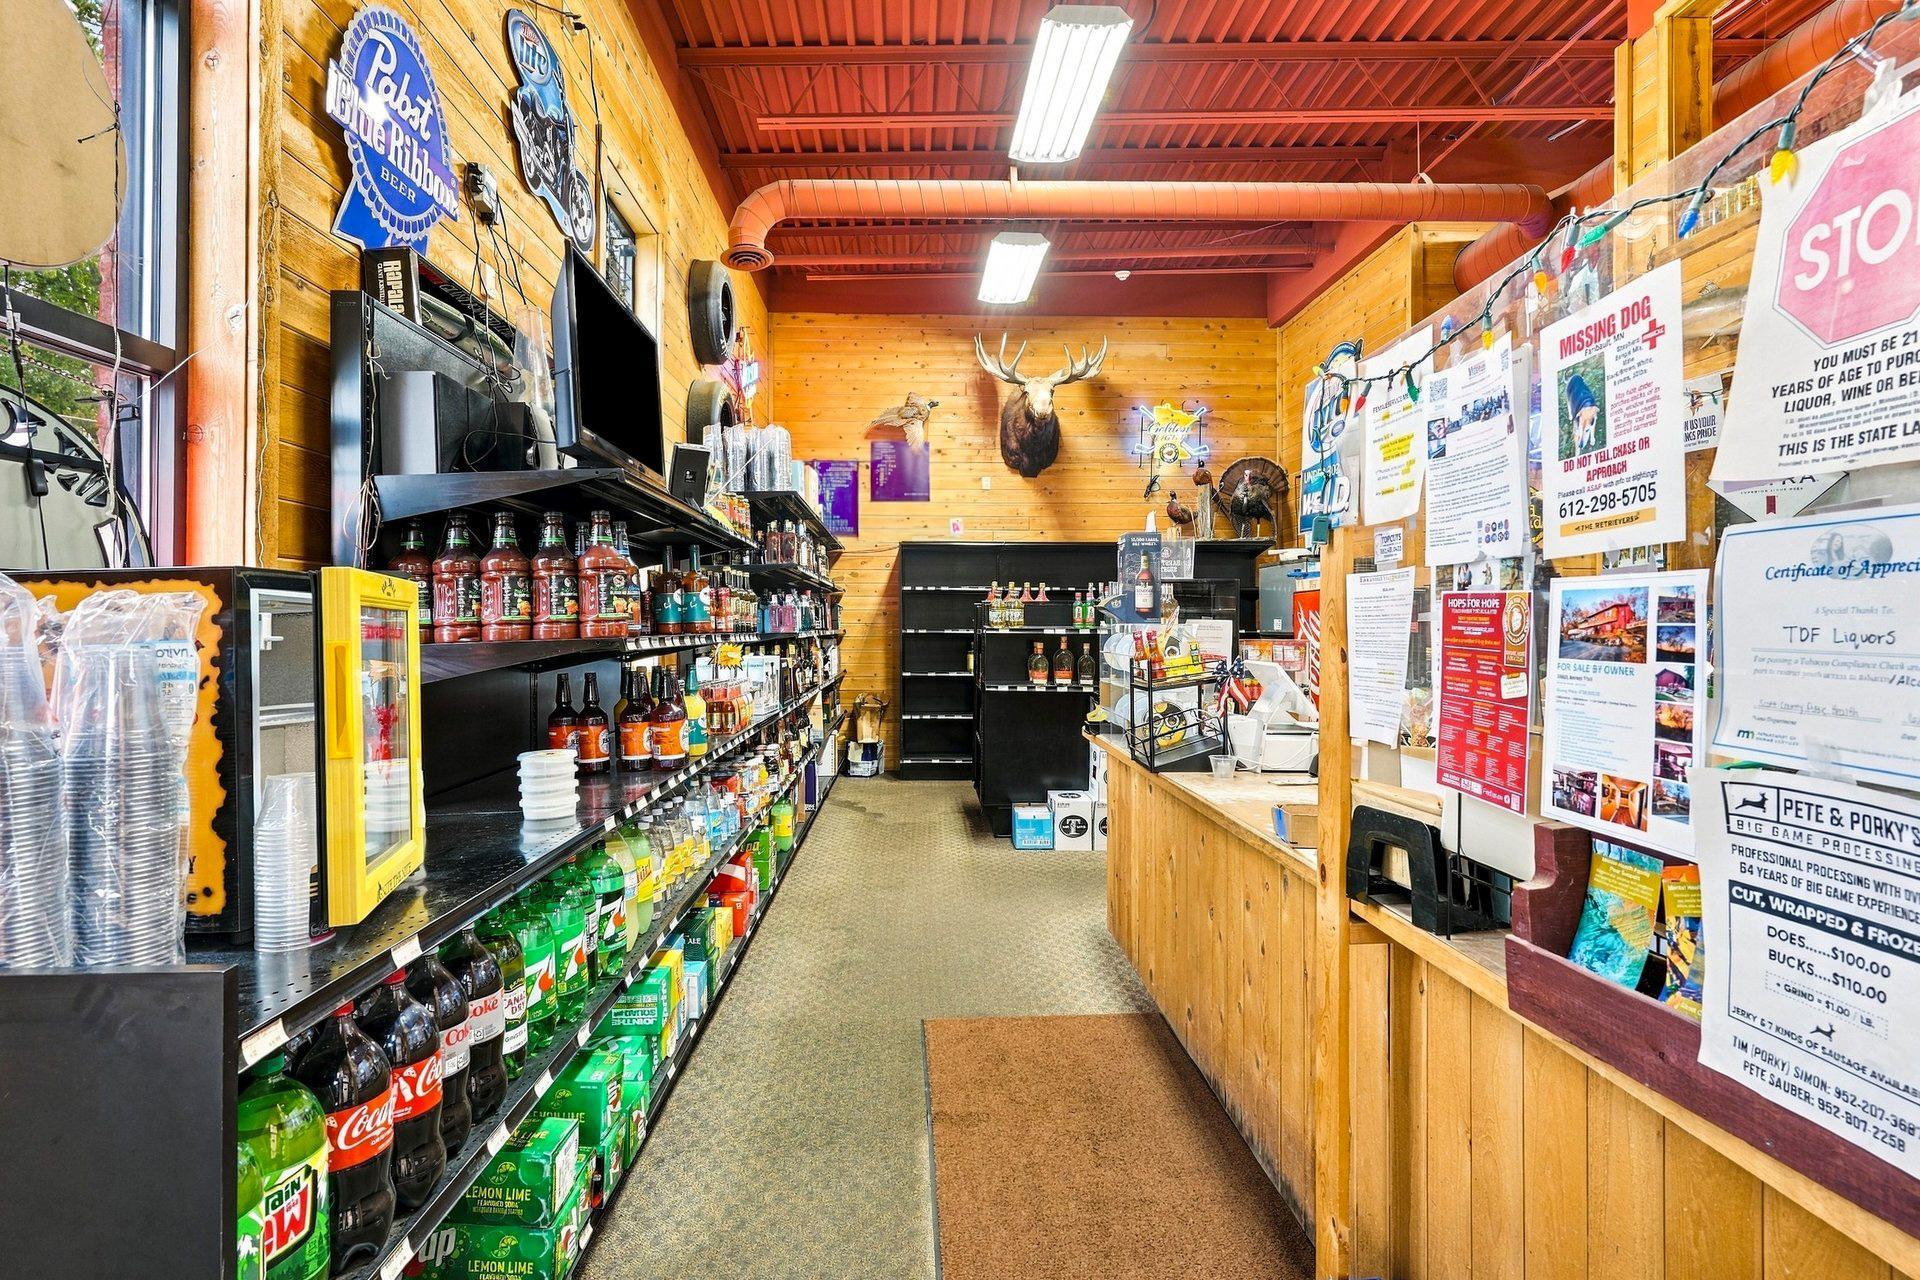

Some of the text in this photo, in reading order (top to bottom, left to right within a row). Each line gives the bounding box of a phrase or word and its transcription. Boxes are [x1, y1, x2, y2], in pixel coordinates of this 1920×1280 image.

[367, 28, 433, 142] Pabst
[329, 66, 458, 213] Blue Ribbon
[380, 165, 416, 204] BEER
[1794, 178, 1920, 291] STO
[383, 259, 406, 314] Rapala
[1560, 295, 1651, 359] MISSING DOG
[1814, 330, 1918, 372] YOU MUST BE 21
[1772, 379, 1813, 398] YEARS
[1818, 374, 1834, 389] OF
[1838, 366, 1863, 385] AGE
[1867, 360, 1882, 377] TO
[1784, 369, 1920, 413] LIQUOR, WINE OR BE
[1697, 427, 1716, 439] PRIDE
[1778, 441, 1808, 457] THIS
[1813, 438, 1826, 453] IS
[1831, 433, 1854, 450] THE
[1858, 424, 1897, 445] STATE
[1563, 460, 1574, 473] DO
[1576, 454, 1592, 469] NOT
[1638, 436, 1650, 450] OR
[1586, 460, 1627, 482] APPROACH
[1558, 489, 1575, 499] Please
[1575, 487, 1586, 495] call
[1632, 469, 1658, 482] sightings
[1559, 482, 1657, 519] 612-298-5705
[1581, 515, 1634, 531] THE RETRIEVERS
[1765, 562, 1833, 582] Certificate
[1838, 559, 1856, 580] of
[1448, 599, 1500, 608] HOPS FOR HOPE
[1821, 606, 1848, 616] Special
[1851, 606, 1878, 615] Thanks
[1782, 625, 1897, 650] TDF Liquors
[1557, 662, 1635, 676] FOR SALE BY OWNER
[1831, 660, 1877, 670] Compliance
[1879, 661, 1904, 671] Check
[1736, 819, 1763, 834] BIG
[1772, 826, 1813, 845] GAME
[1784, 798, 1920, 848] PETE & PORKY'S
[1731, 843, 1803, 872] PROFESSIONAL
[1806, 862, 1871, 890] PROCESSING
[1874, 880, 1901, 898] WITH
[1731, 885, 1766, 908] CUT,
[1768, 895, 1848, 931] WRAPPED
[1851, 921, 1864, 937] &
[1740, 862, 1920, 924] 64 YEARS OF BIG GAME EXPERIENCE
[1784, 984, 1814, 1002] GRIND
[1732, 1005, 1757, 1023] JERKY
[1767, 1020, 1774, 1030] 7
[1775, 1024, 1803, 1044] KINDS
[1806, 1039, 1819, 1051] OF
[1821, 1046, 1868, 1075] SAUSAGE
[1732, 1035, 1748, 1054] TIM
[1751, 1044, 1790, 1076] (PORKY)
[1793, 1066, 1831, 1095] SIMON:
[1743, 1060, 1766, 1082] PETE
[1768, 1072, 1815, 1107] SAUBER:
[466, 1186, 531, 1201] LEMON LIME
[468, 1259, 533, 1274] LEMON LIME
